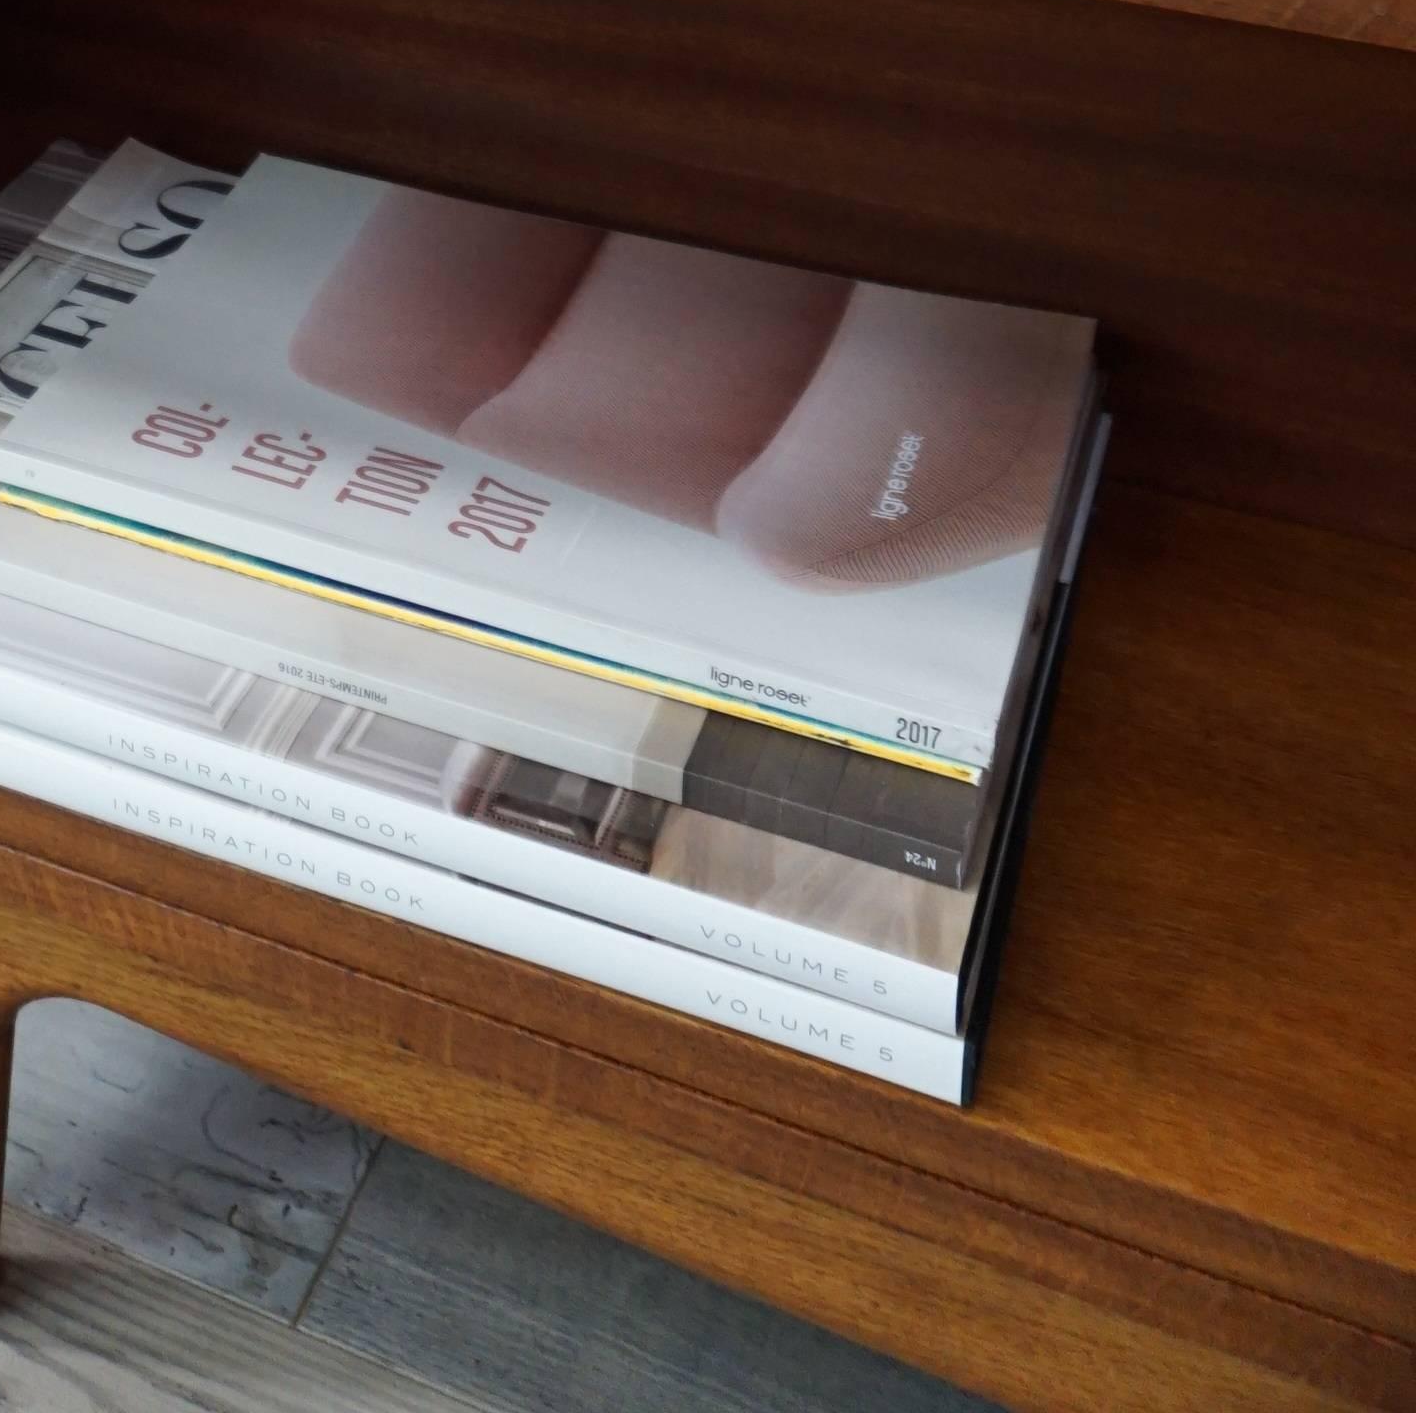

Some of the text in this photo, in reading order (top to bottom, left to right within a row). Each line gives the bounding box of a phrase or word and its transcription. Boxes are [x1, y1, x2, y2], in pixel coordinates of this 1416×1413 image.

[132, 403, 230, 458] COL-
[231, 432, 327, 489] LEC-
[334, 445, 444, 516] TION
[871, 436, 926, 520] ligne roset
[448, 476, 551, 553] 2017
[278, 662, 303, 678] 2016
[710, 666, 808, 707] ligne roset
[896, 717, 941, 749] 2017
[109, 734, 311, 810] INSPIRATION
[331, 807, 419, 845] BOOK
[700, 925, 848, 983] VOLUME
[873, 981, 887, 995] 5
[114, 798, 316, 875] INSPIRATION
[337, 872, 424, 910] BOOK
[706, 991, 855, 1050] VOLUME
[880, 1047, 893, 1062] 5
